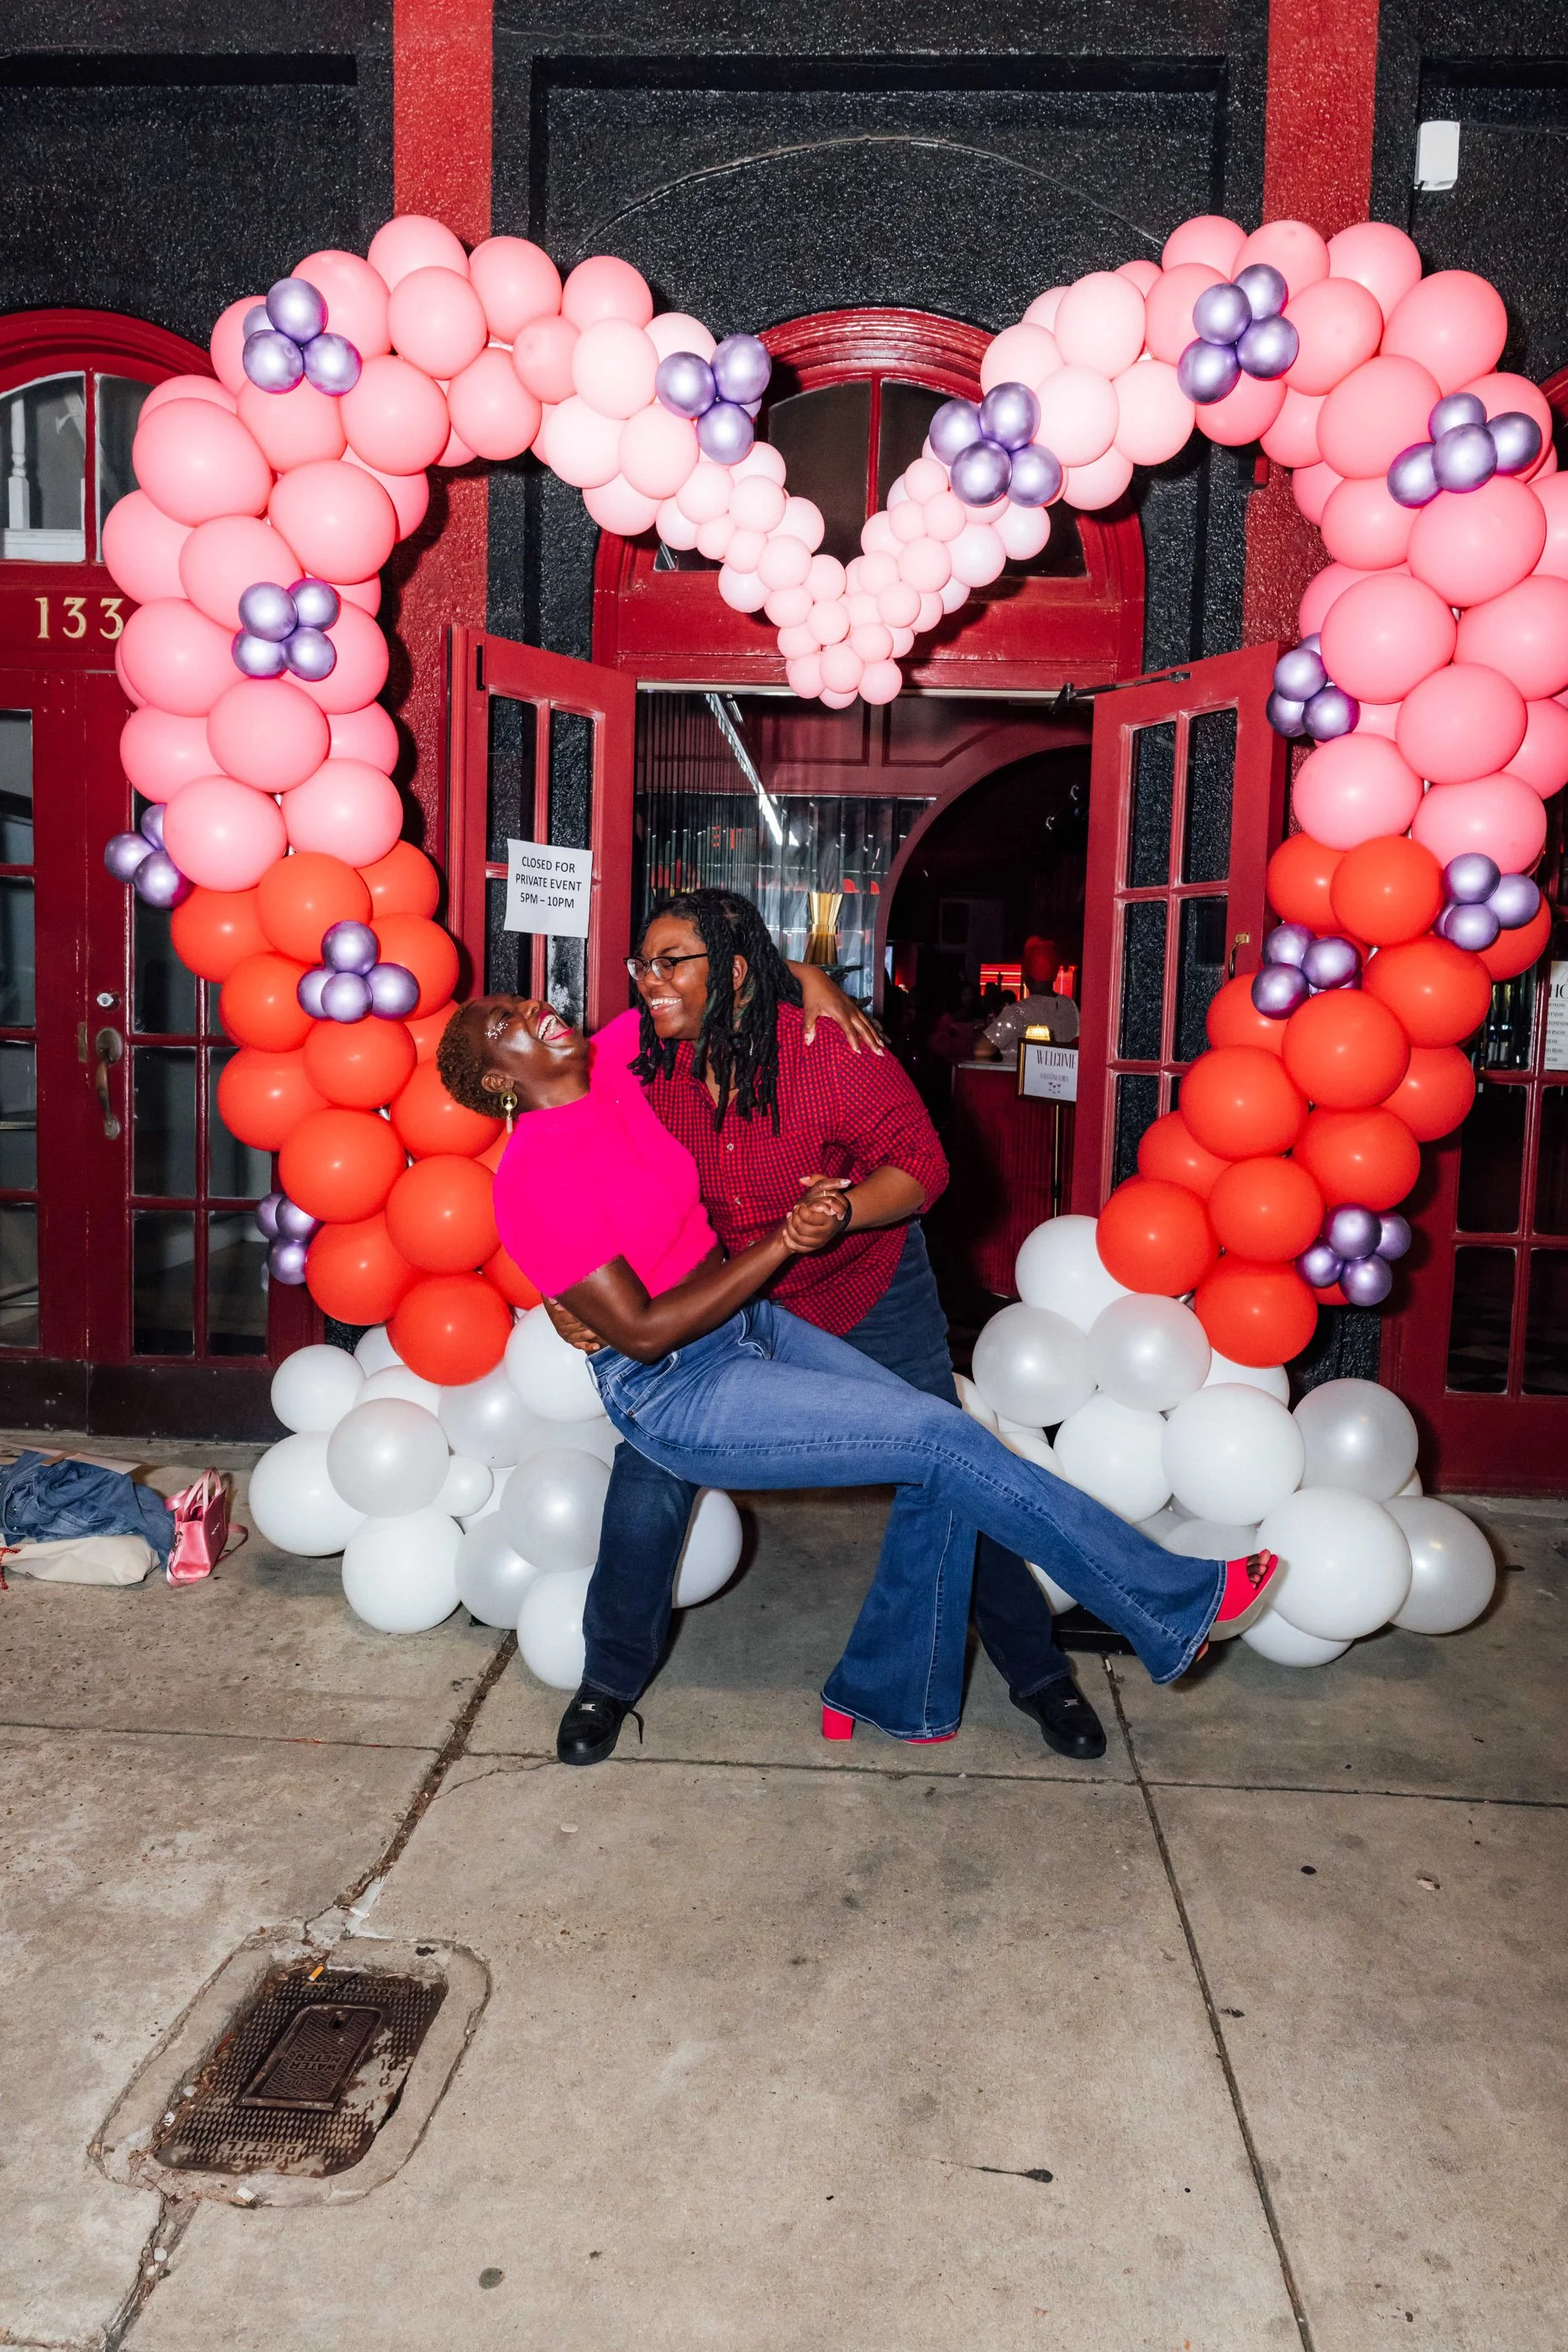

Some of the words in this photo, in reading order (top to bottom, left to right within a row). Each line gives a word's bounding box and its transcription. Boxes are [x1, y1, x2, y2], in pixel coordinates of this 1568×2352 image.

[34, 596, 125, 640] 133
[522, 856, 553, 870] CLOSED
[555, 861, 575, 874] FOR
[516, 874, 548, 888] PRIVATE
[550, 879, 582, 891] EVENT
[520, 892, 538, 904] 5PM
[547, 896, 574, 908] 10PM
[1036, 1049, 1078, 1069] WELCOME
[289, 2061, 337, 2071] WATER
[295, 2053, 343, 2063] METER
